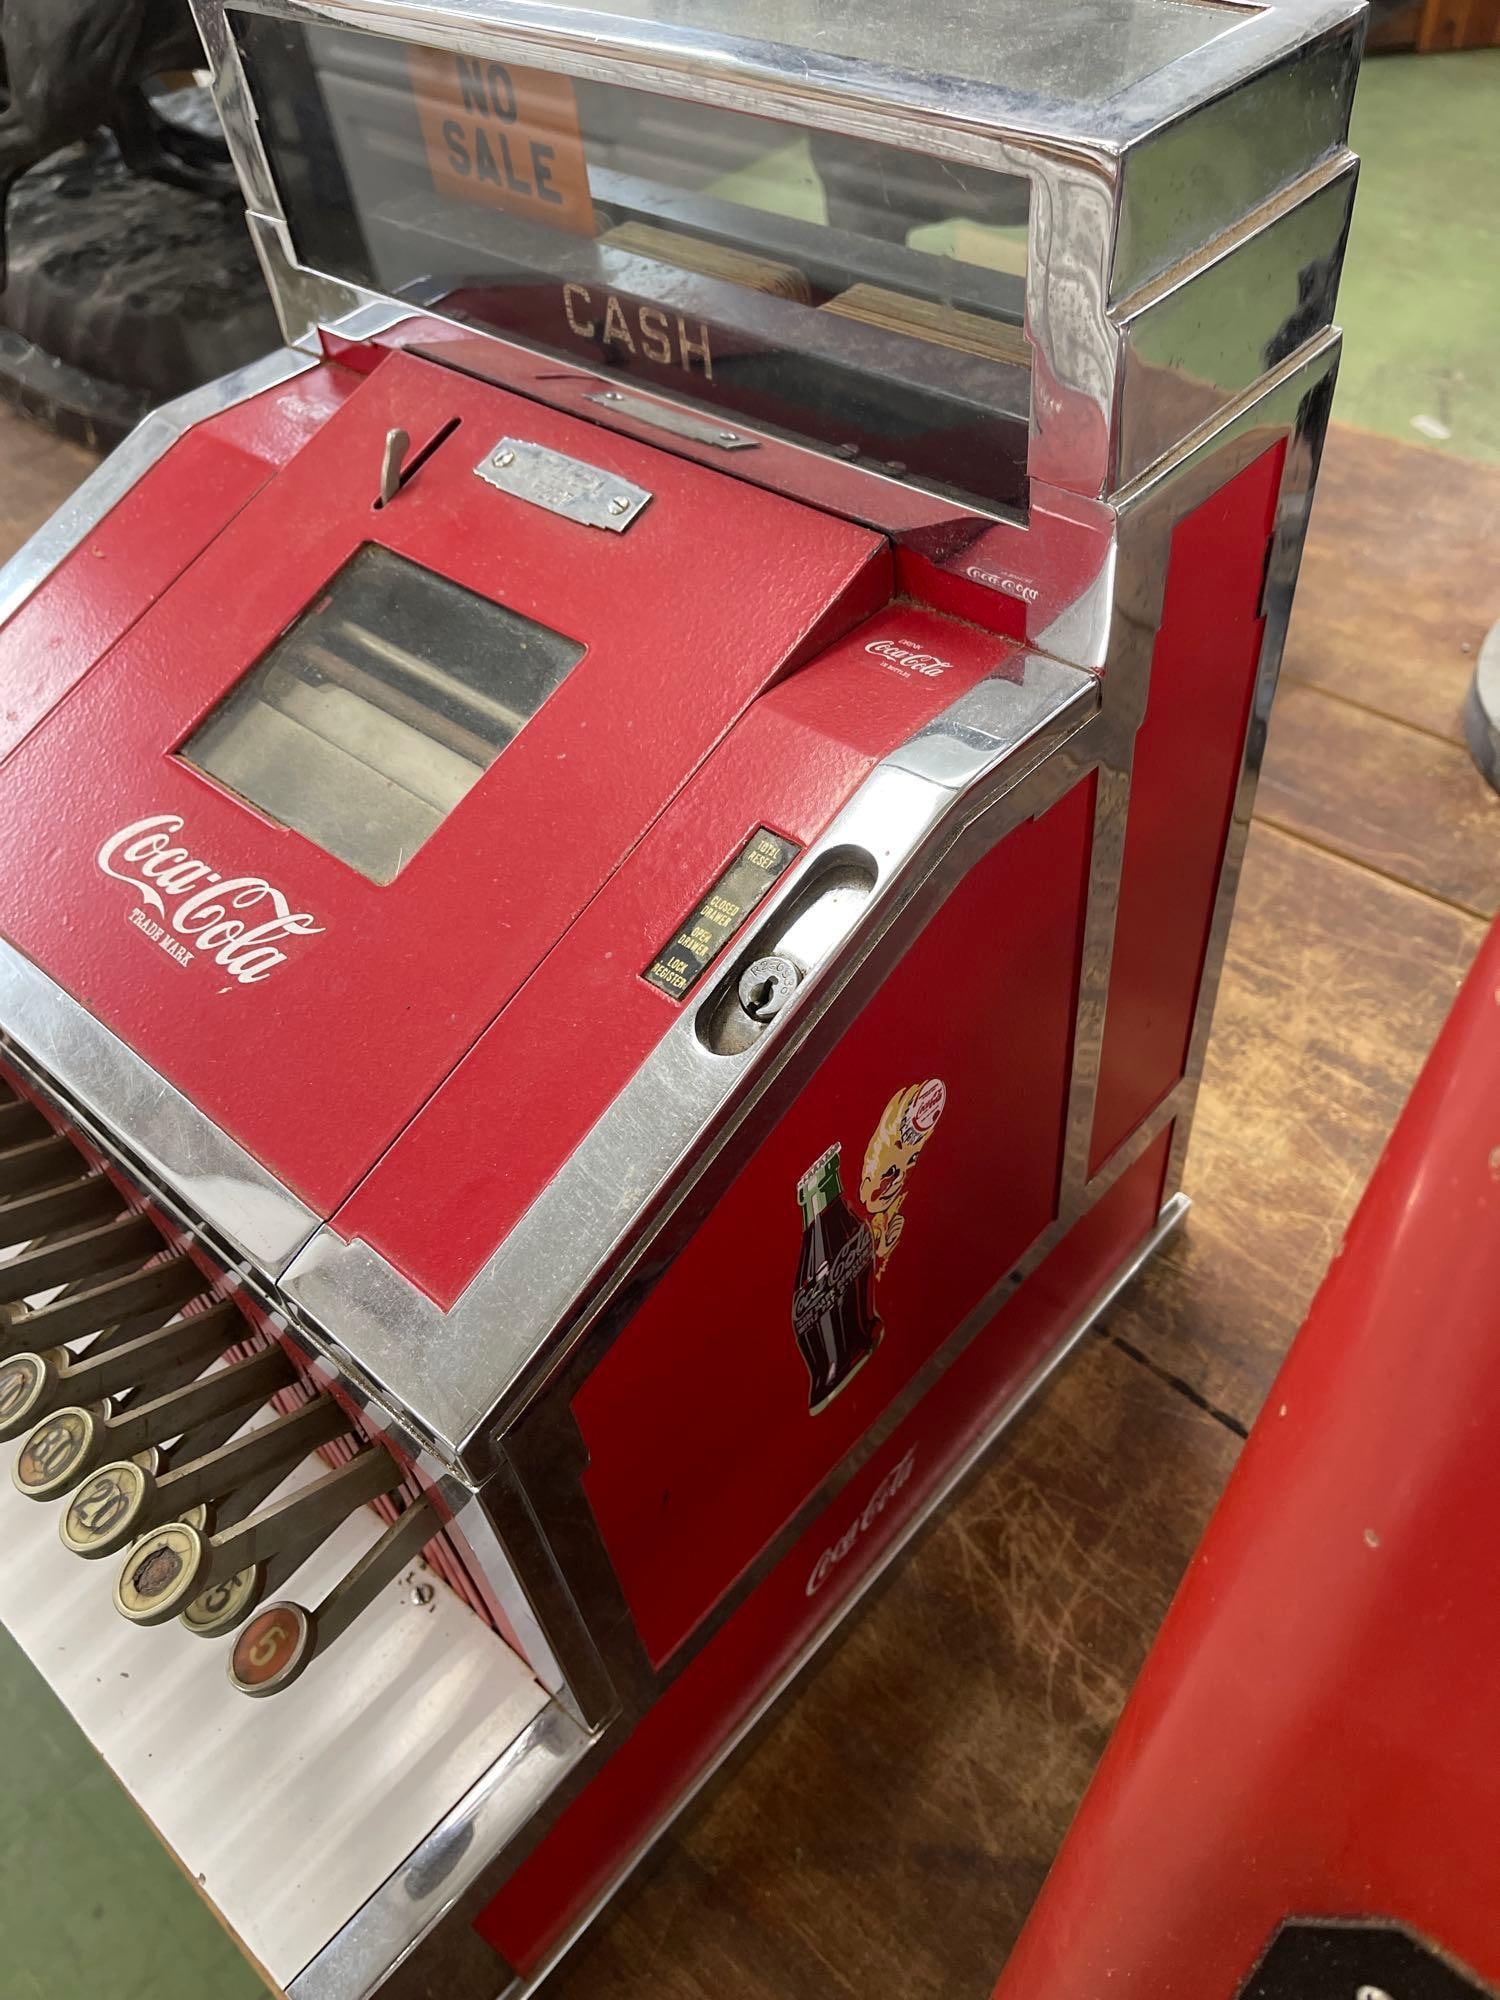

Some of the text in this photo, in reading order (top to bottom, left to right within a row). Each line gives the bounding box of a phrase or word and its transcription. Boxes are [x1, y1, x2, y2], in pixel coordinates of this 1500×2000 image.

[455, 56, 518, 124] NO
[442, 119, 564, 205] SALE
[562, 282, 713, 380] CASH
[864, 640, 954, 677] Coca-Cola
[747, 851, 775, 870] RESET
[757, 840, 782, 860] TOTAL
[97, 814, 327, 984] Coca-Cola
[710, 895, 740, 917] CLOSED
[700, 905, 733, 928] DRAWER
[128, 907, 195, 968] TRADE MARK
[677, 934, 709, 957] DRAWER
[690, 926, 713, 942] OPEN
[651, 962, 688, 989] REGISTER
[667, 956, 689, 974] LOCK
[74, 1477, 131, 1536] 20
[249, 1625, 289, 1668] 5
